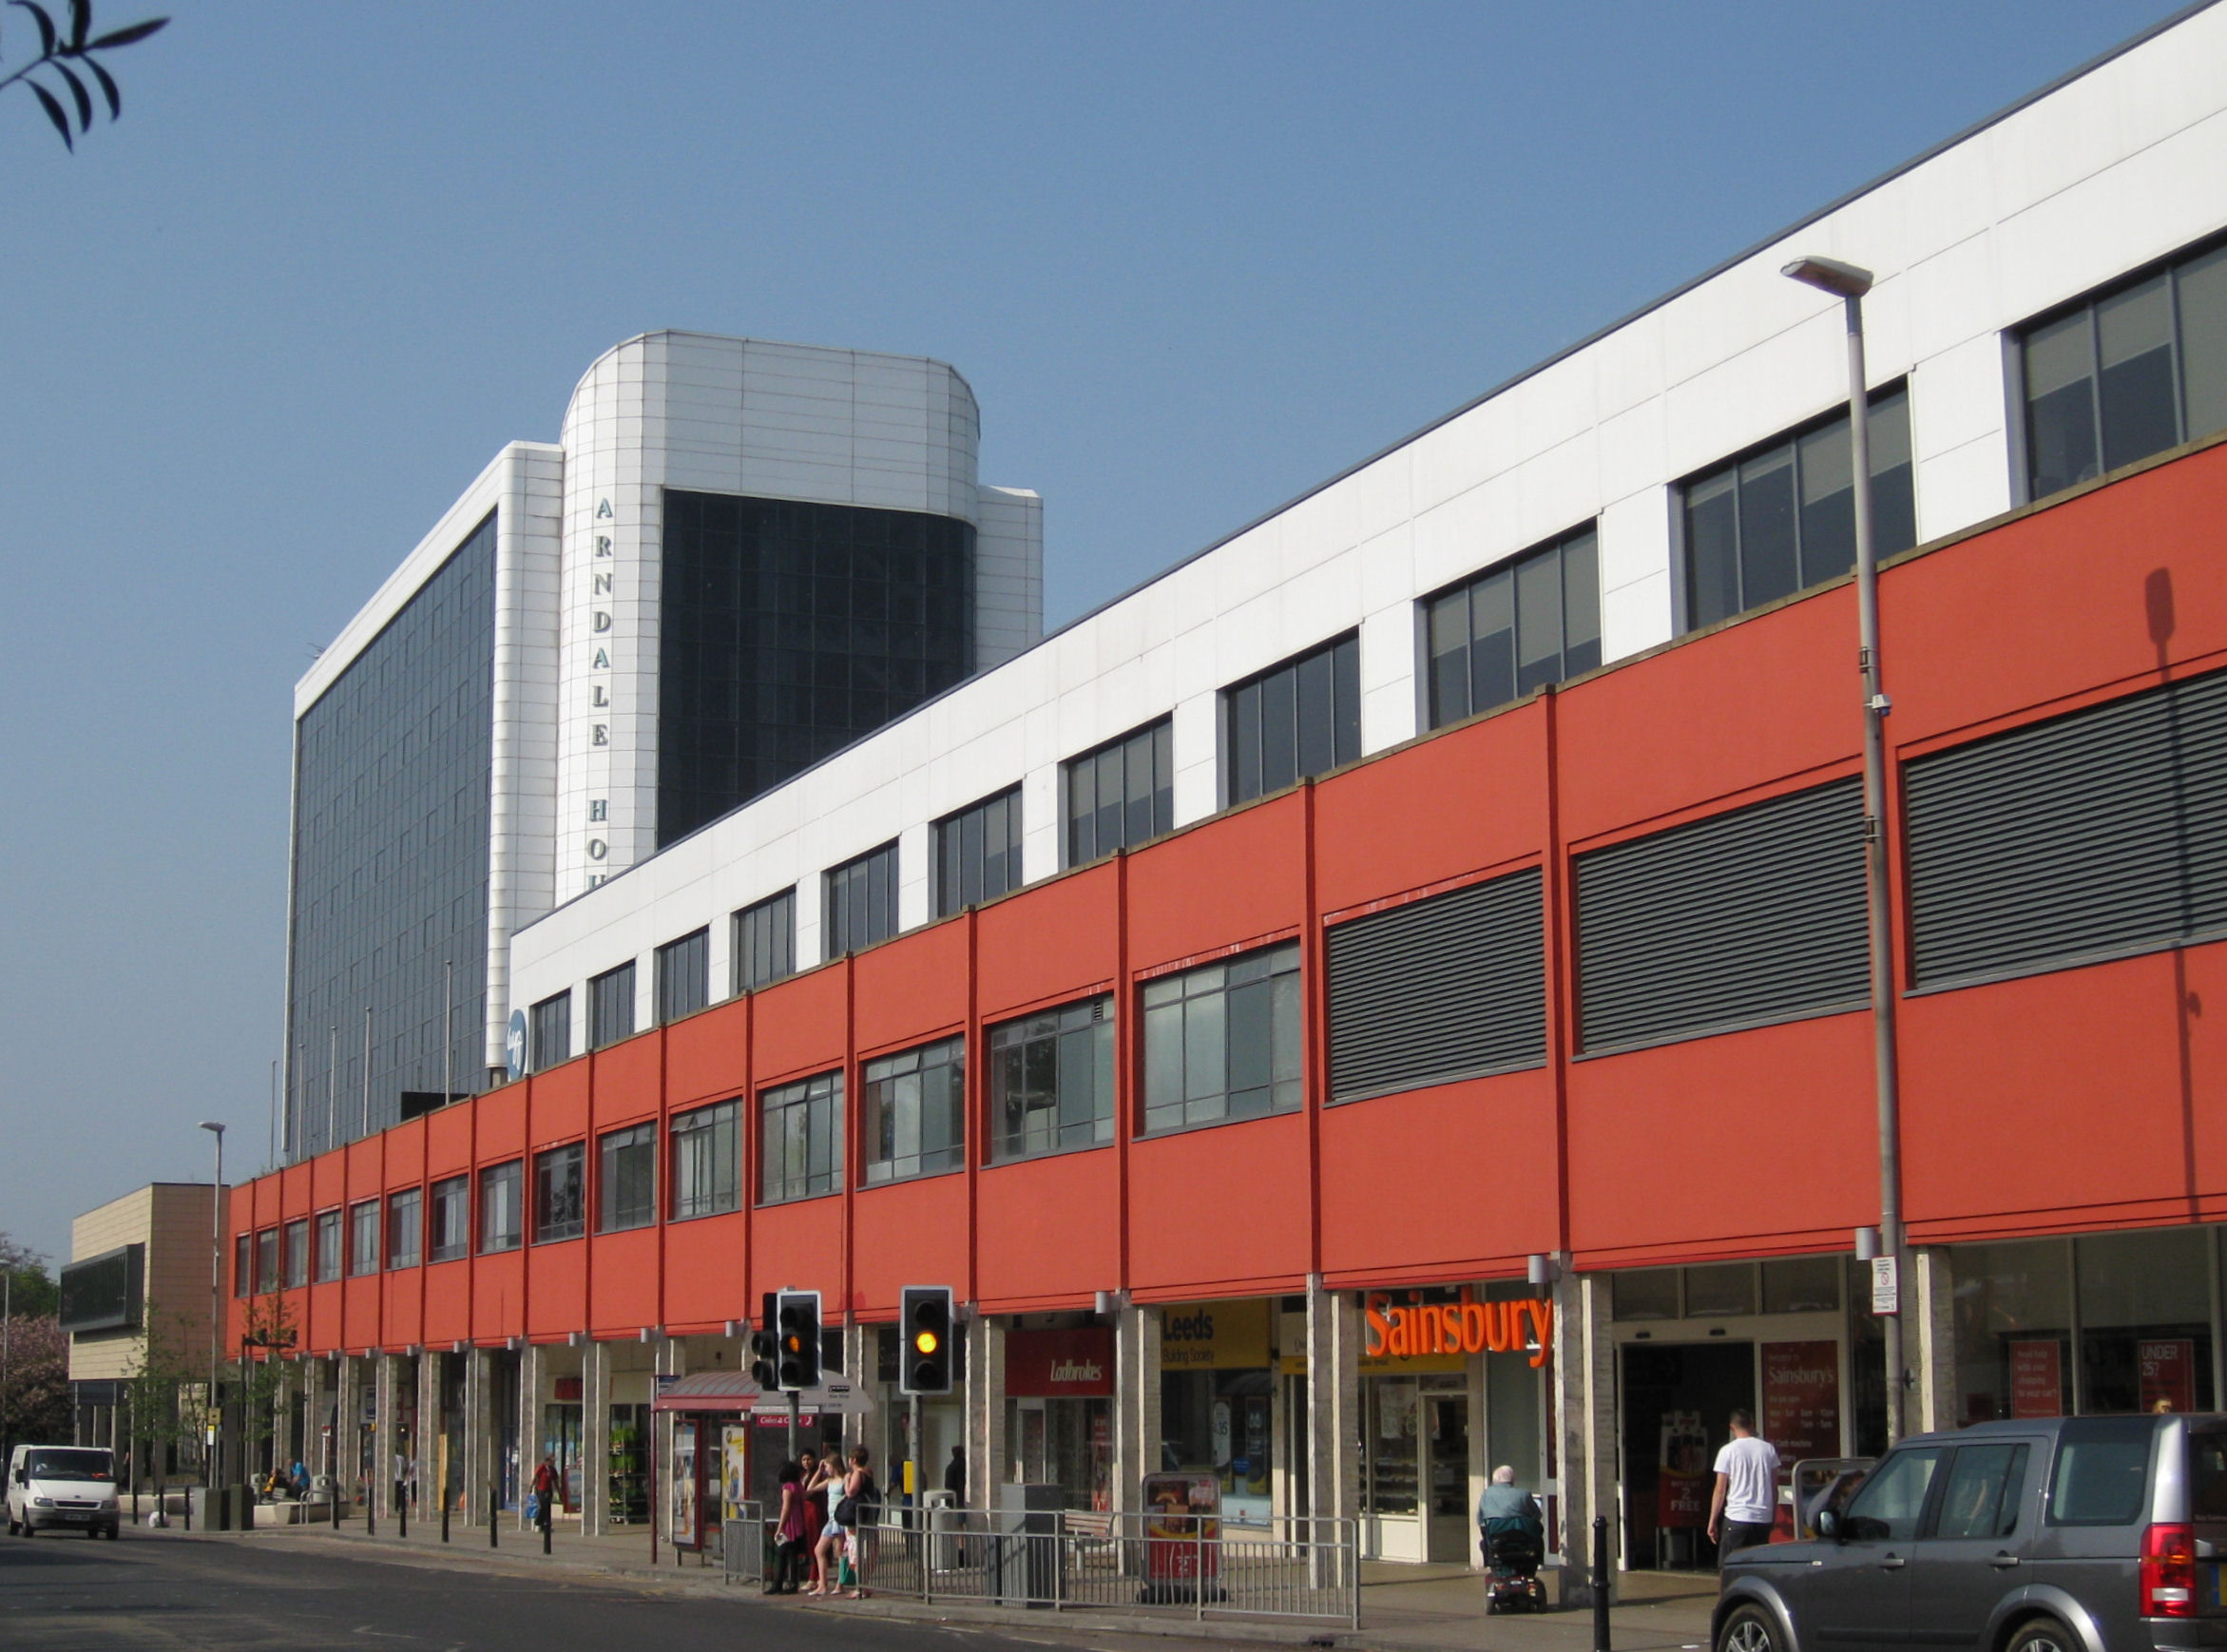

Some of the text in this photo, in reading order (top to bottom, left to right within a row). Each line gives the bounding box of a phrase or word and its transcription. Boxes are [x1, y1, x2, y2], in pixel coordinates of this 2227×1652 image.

[591, 497, 613, 746] ARNDALE
[1162, 1308, 1214, 1341] Leeds
[1162, 1347, 1214, 1365] Building Society
[2141, 1344, 2179, 1360] UNDER
[1050, 1358, 1103, 1382] Ladbrokes
[1769, 1365, 1834, 1388] Sainsbury's
[2142, 1361, 2160, 1376] 25?
[1681, 1487, 1691, 1500] 2
[1670, 1499, 1701, 1512] FREE
